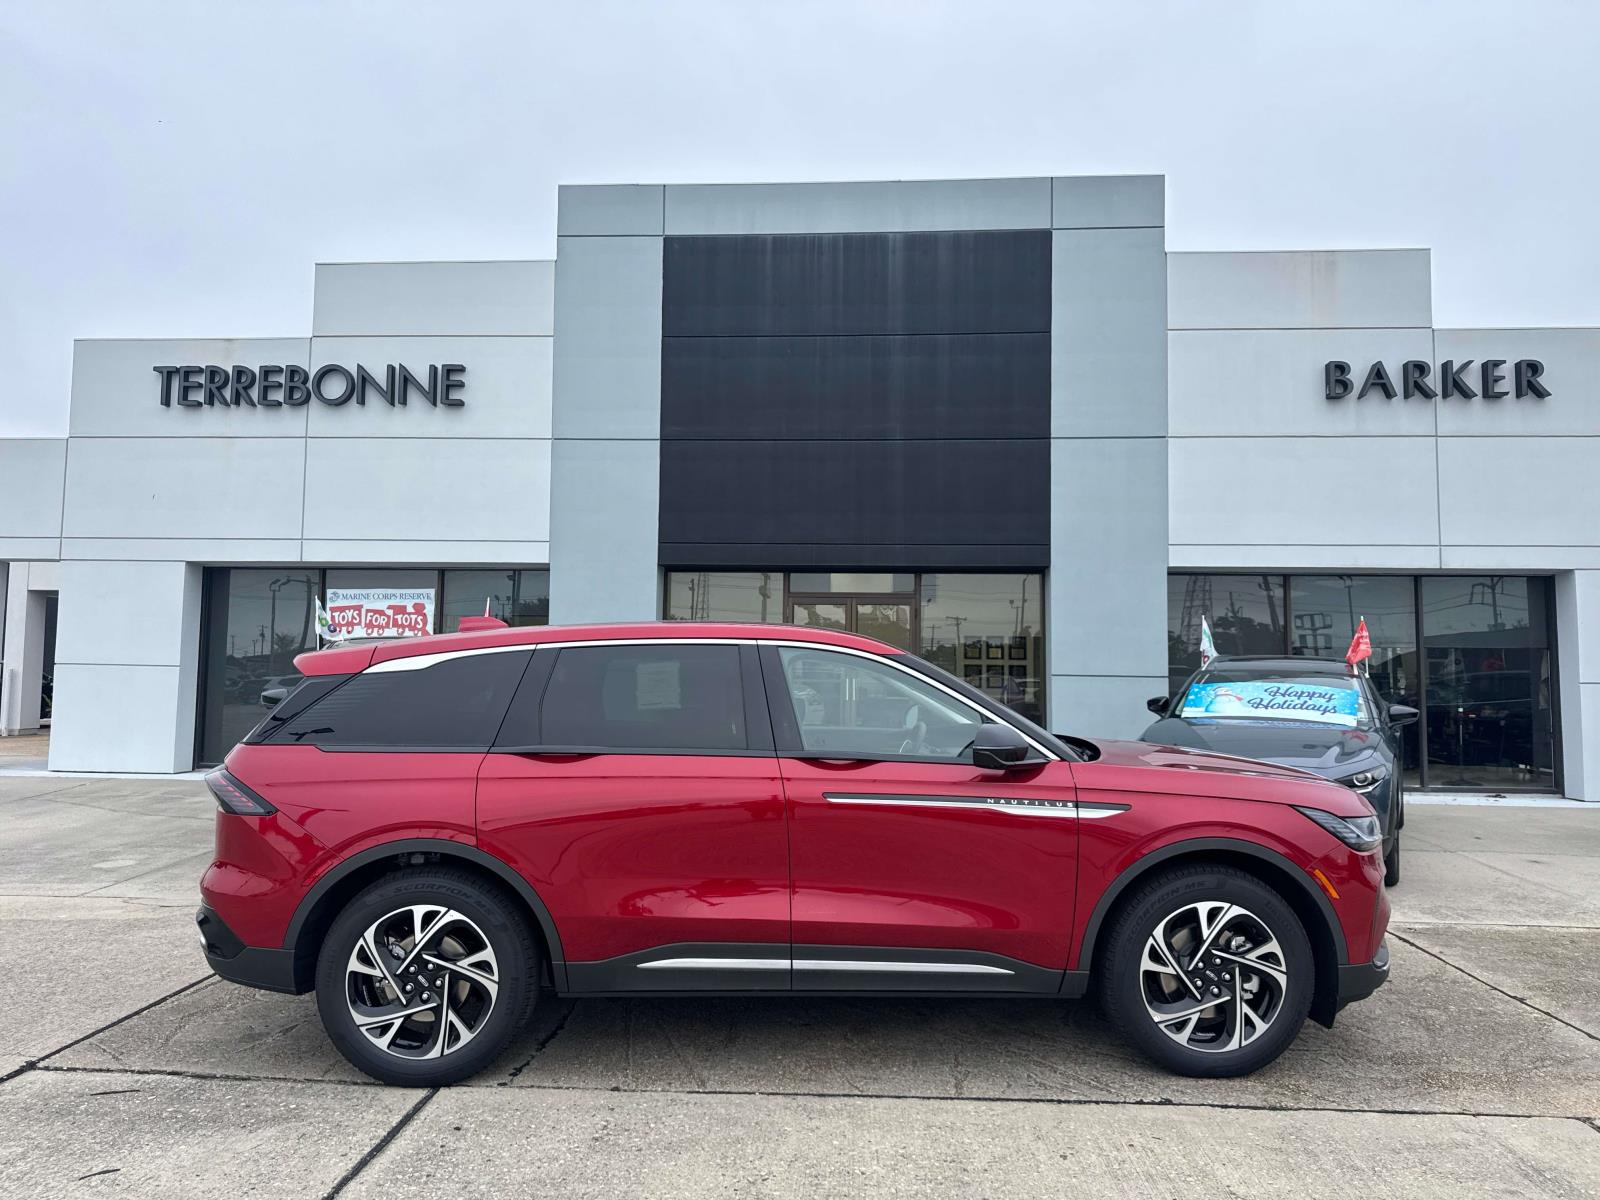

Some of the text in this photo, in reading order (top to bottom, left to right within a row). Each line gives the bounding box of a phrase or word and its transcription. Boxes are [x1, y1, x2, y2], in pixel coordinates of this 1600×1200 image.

[153, 362, 466, 407] TERREBONNE
[1325, 359, 1552, 400] BARKER
[341, 592, 432, 601] MARINE CORPS RESERVE
[332, 609, 424, 629] TOYS FOR TOTS
[1264, 685, 1337, 703] Happy
[1247, 697, 1338, 715] Holidays
[986, 798, 1074, 808] NAUTILUS
[393, 883, 473, 899] SCORPION
